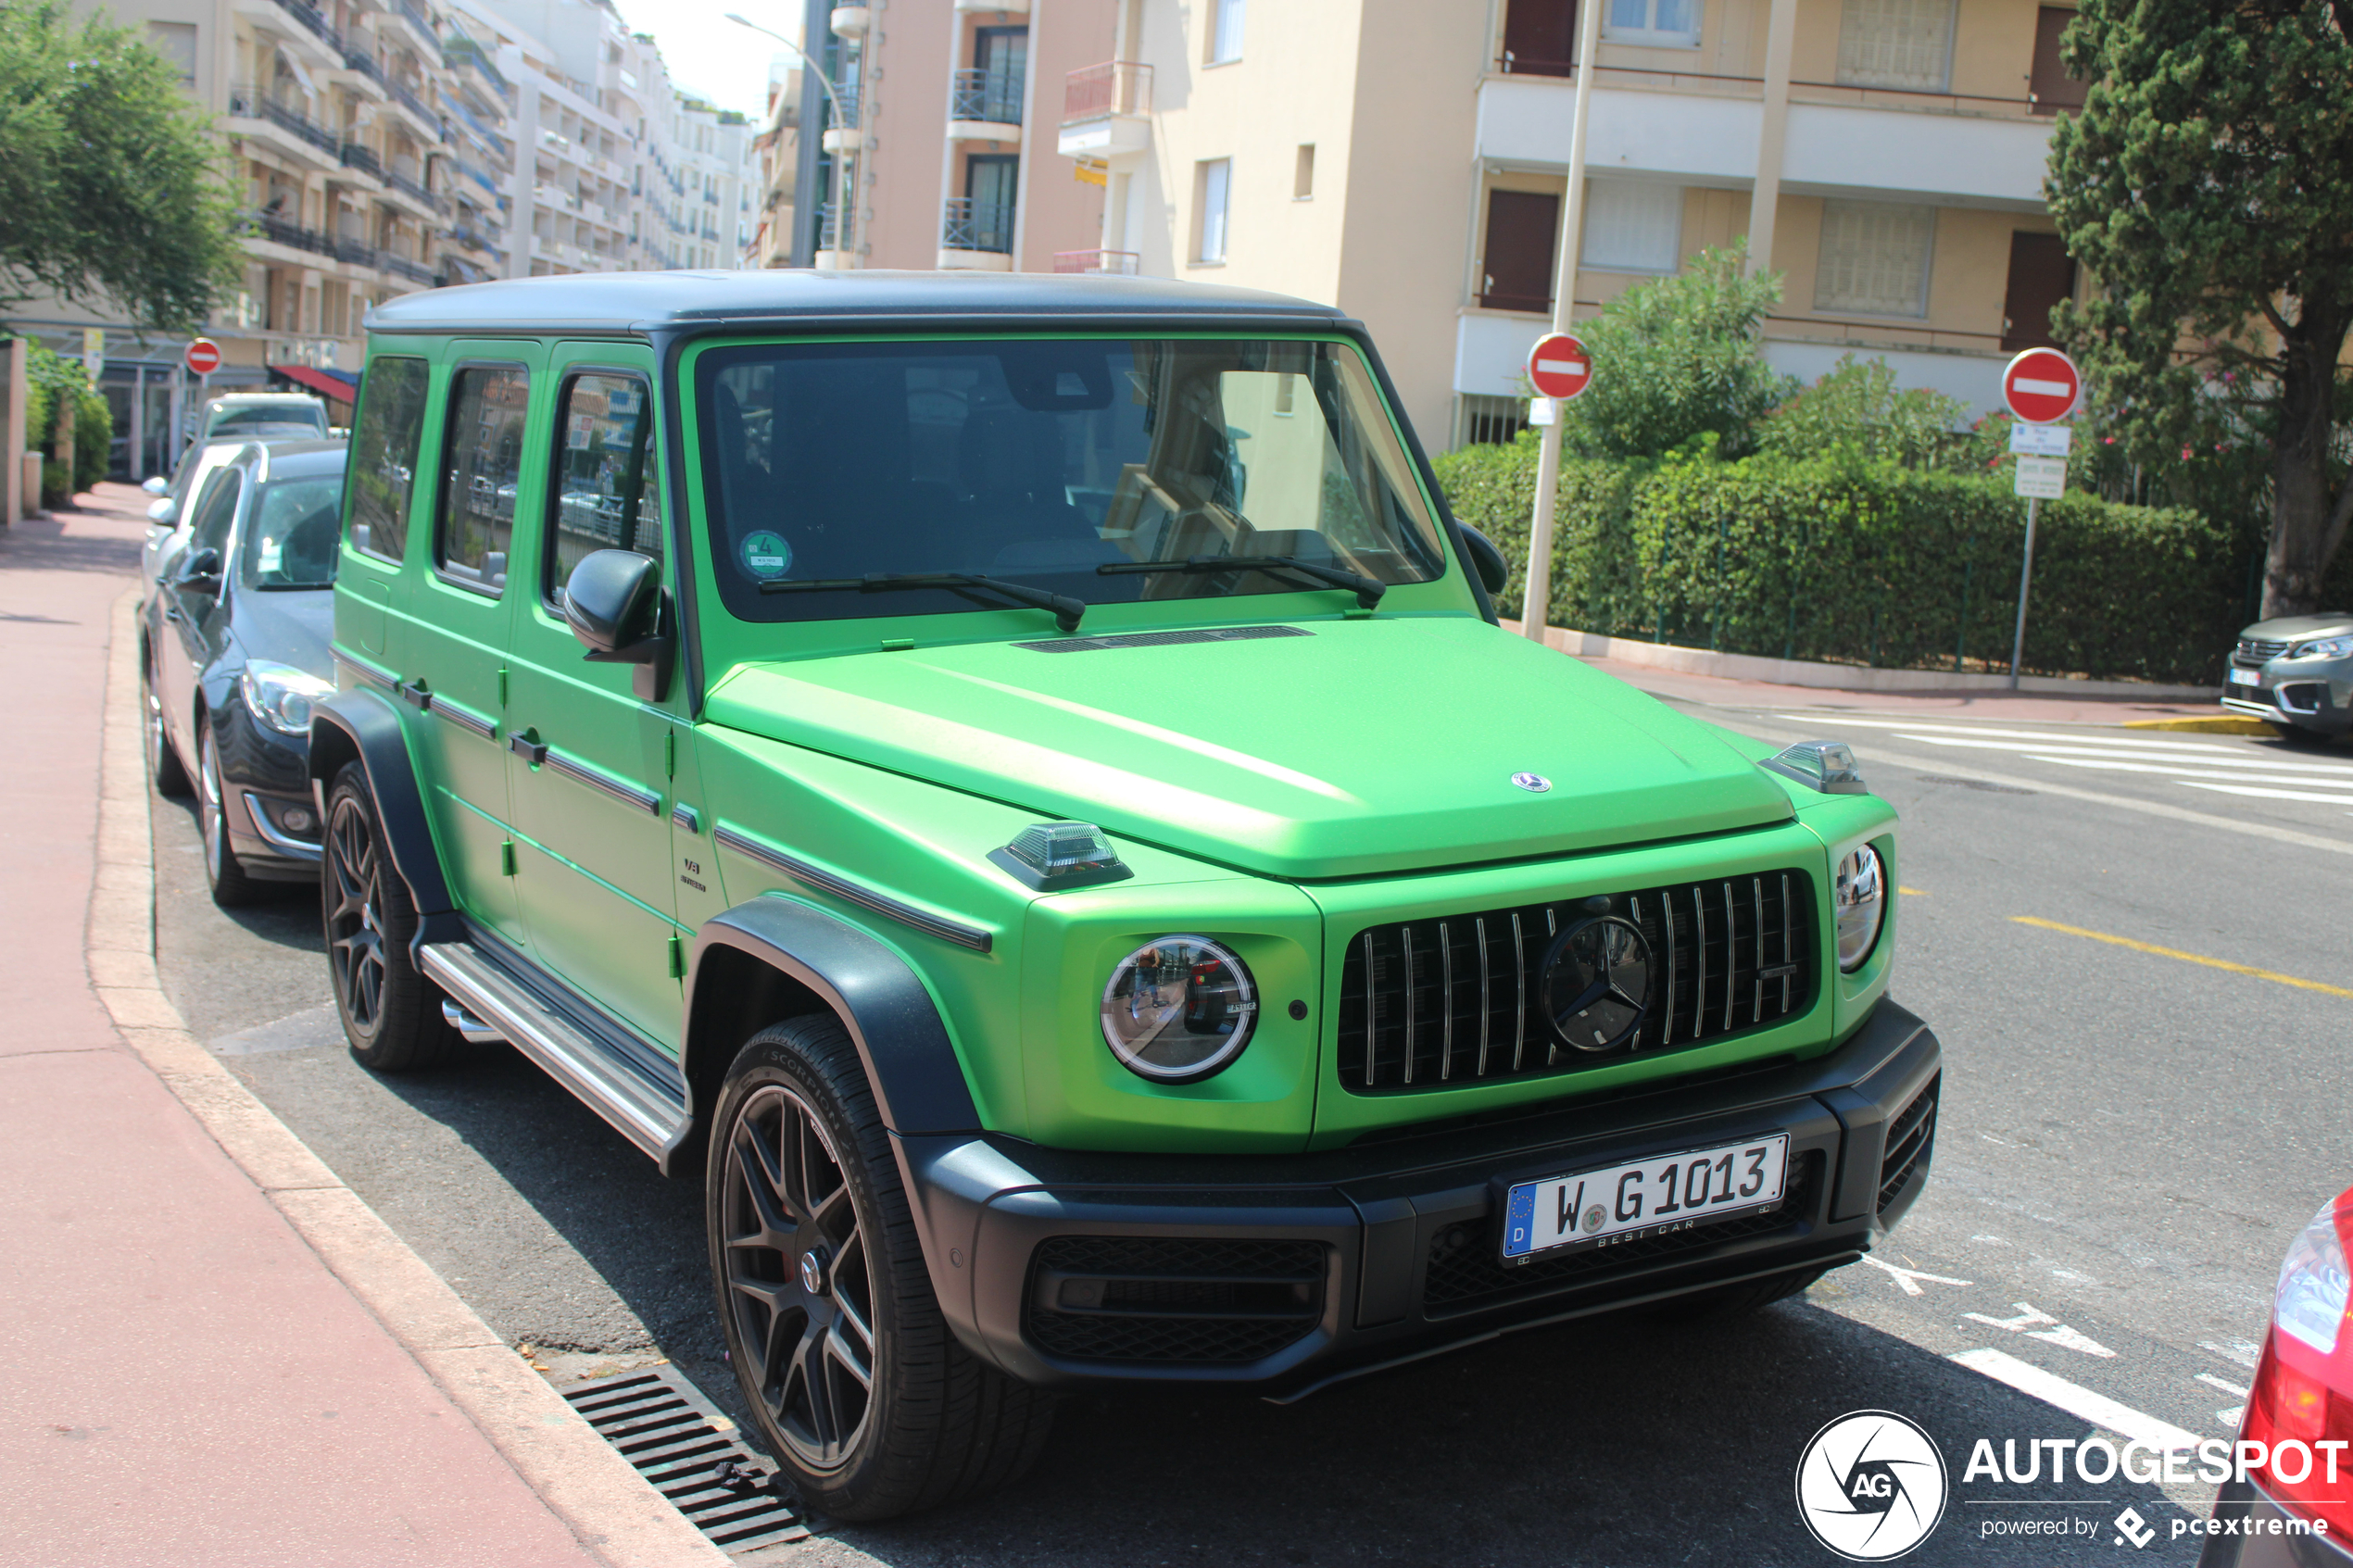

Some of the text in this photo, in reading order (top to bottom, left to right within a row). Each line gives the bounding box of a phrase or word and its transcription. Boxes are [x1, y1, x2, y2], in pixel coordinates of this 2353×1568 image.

[760, 536, 772, 555] 4
[685, 858, 699, 874] V8
[770, 1050, 840, 1131] SCORPION
[1557, 1180, 1585, 1236] W
[1513, 1227, 1524, 1243] D
[1597, 1220, 1694, 1248] BEST CAR
